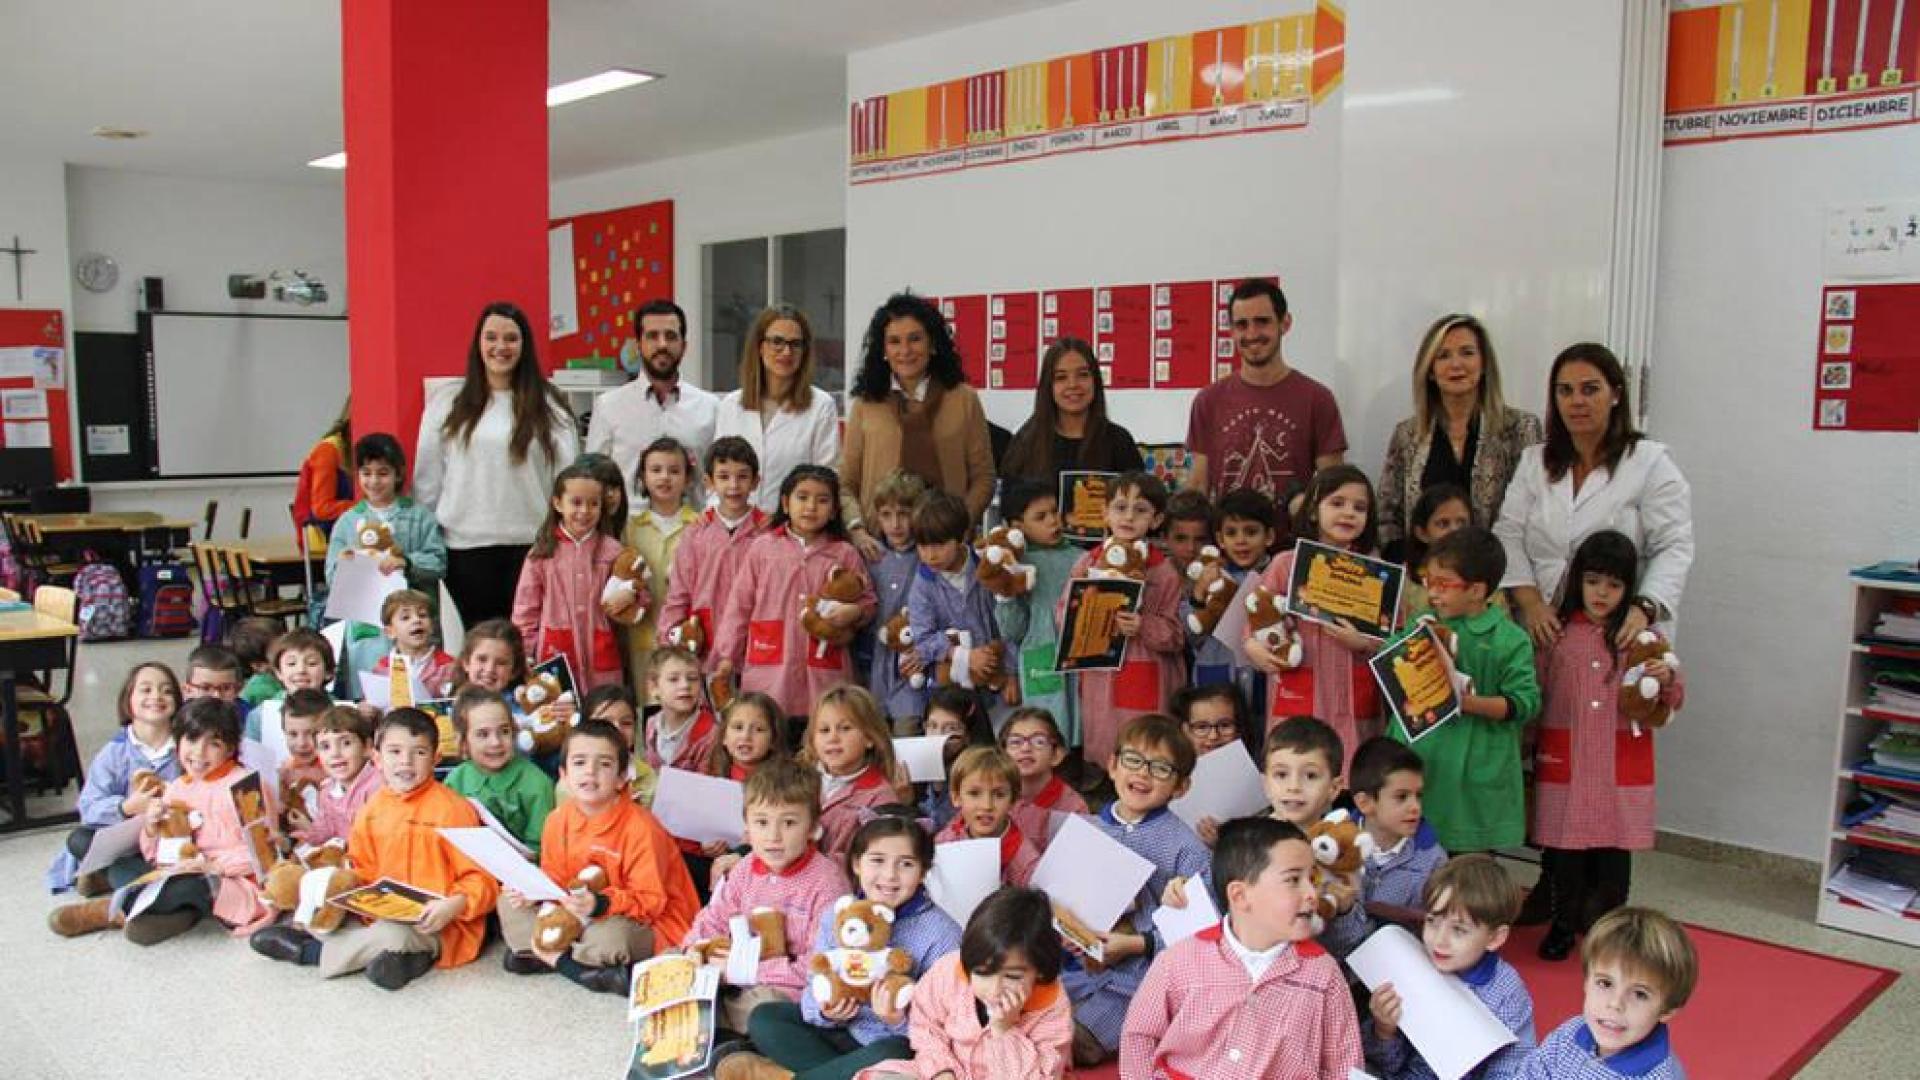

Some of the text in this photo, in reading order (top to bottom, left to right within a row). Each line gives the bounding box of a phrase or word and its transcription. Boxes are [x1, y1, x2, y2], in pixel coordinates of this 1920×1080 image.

[1719, 106, 1808, 127] NOVIEMBRE
[1816, 97, 1909, 122] DICIEMBRE
[1102, 127, 1133, 139] MARZO
[1209, 114, 1238, 127] MAYO
